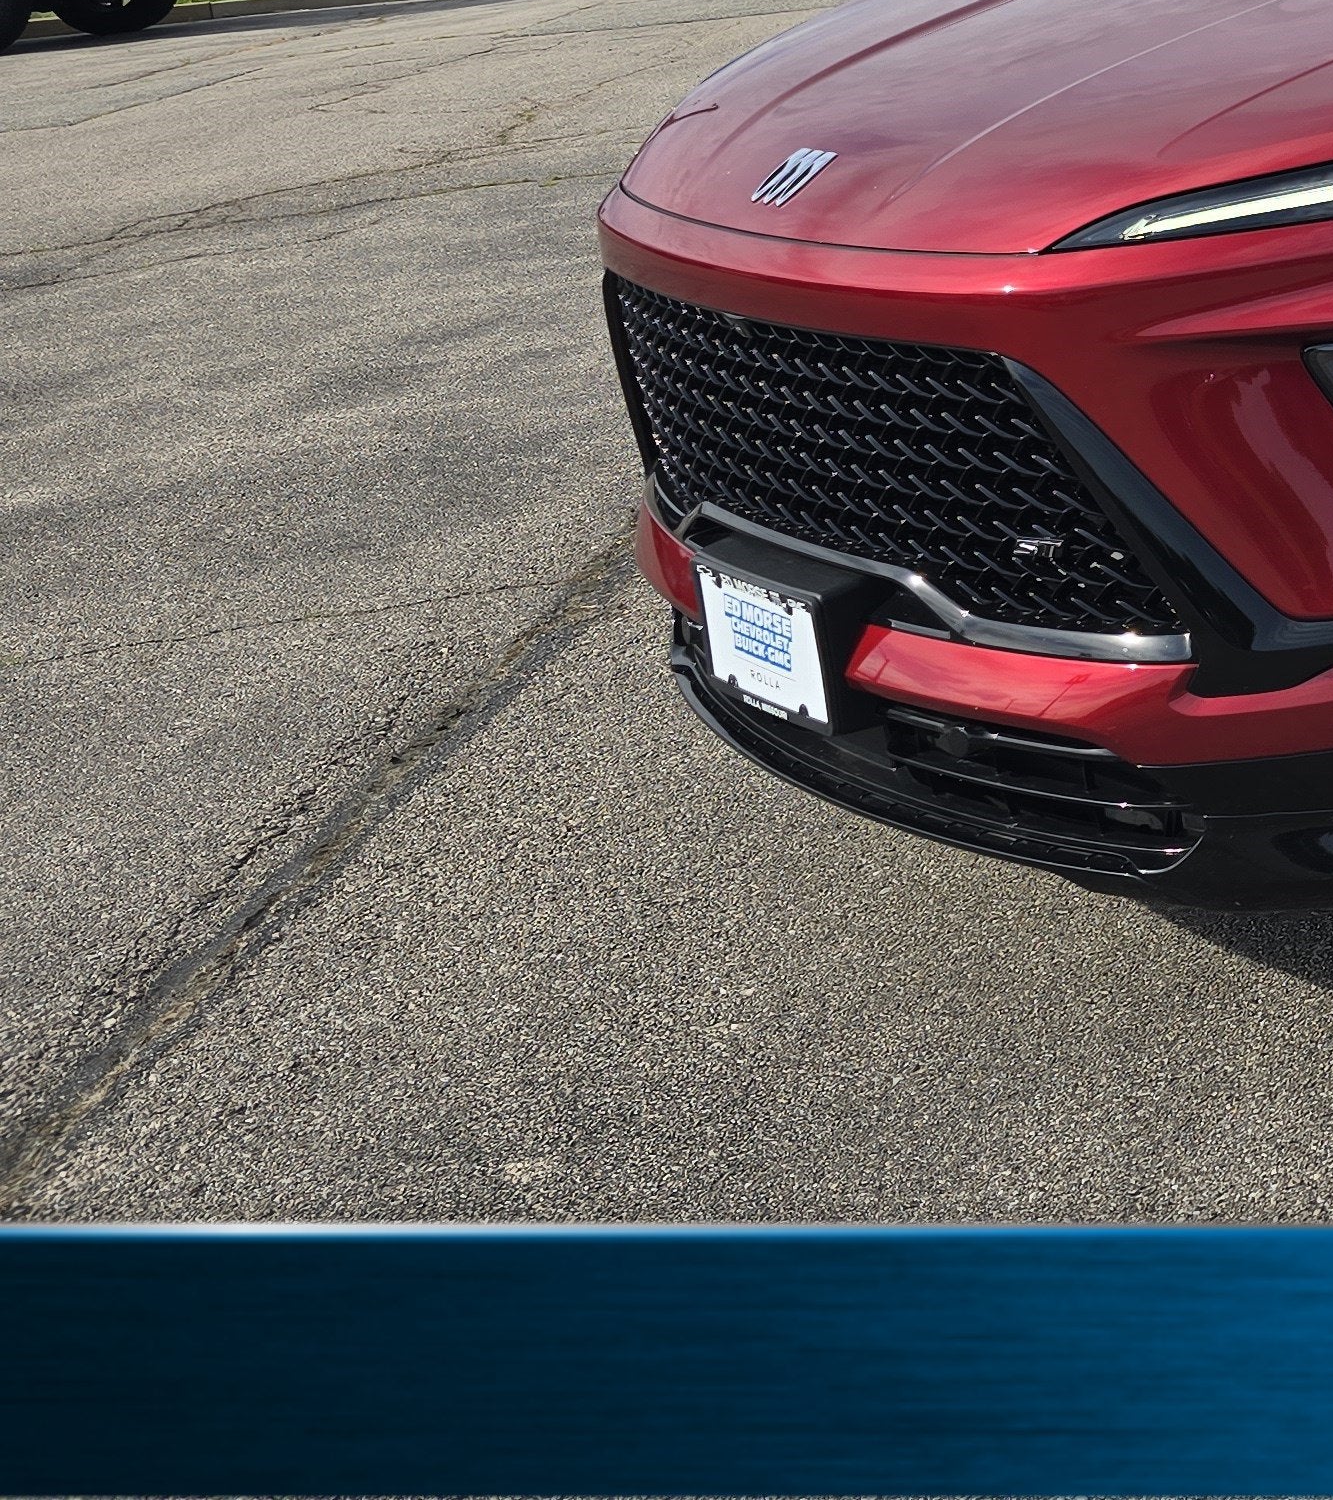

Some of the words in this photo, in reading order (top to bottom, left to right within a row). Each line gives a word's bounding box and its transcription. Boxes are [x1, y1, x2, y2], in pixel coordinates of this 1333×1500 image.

[724, 595, 742, 618] ED
[741, 602, 792, 638] MORSE
[749, 668, 782, 690] ROLLA
